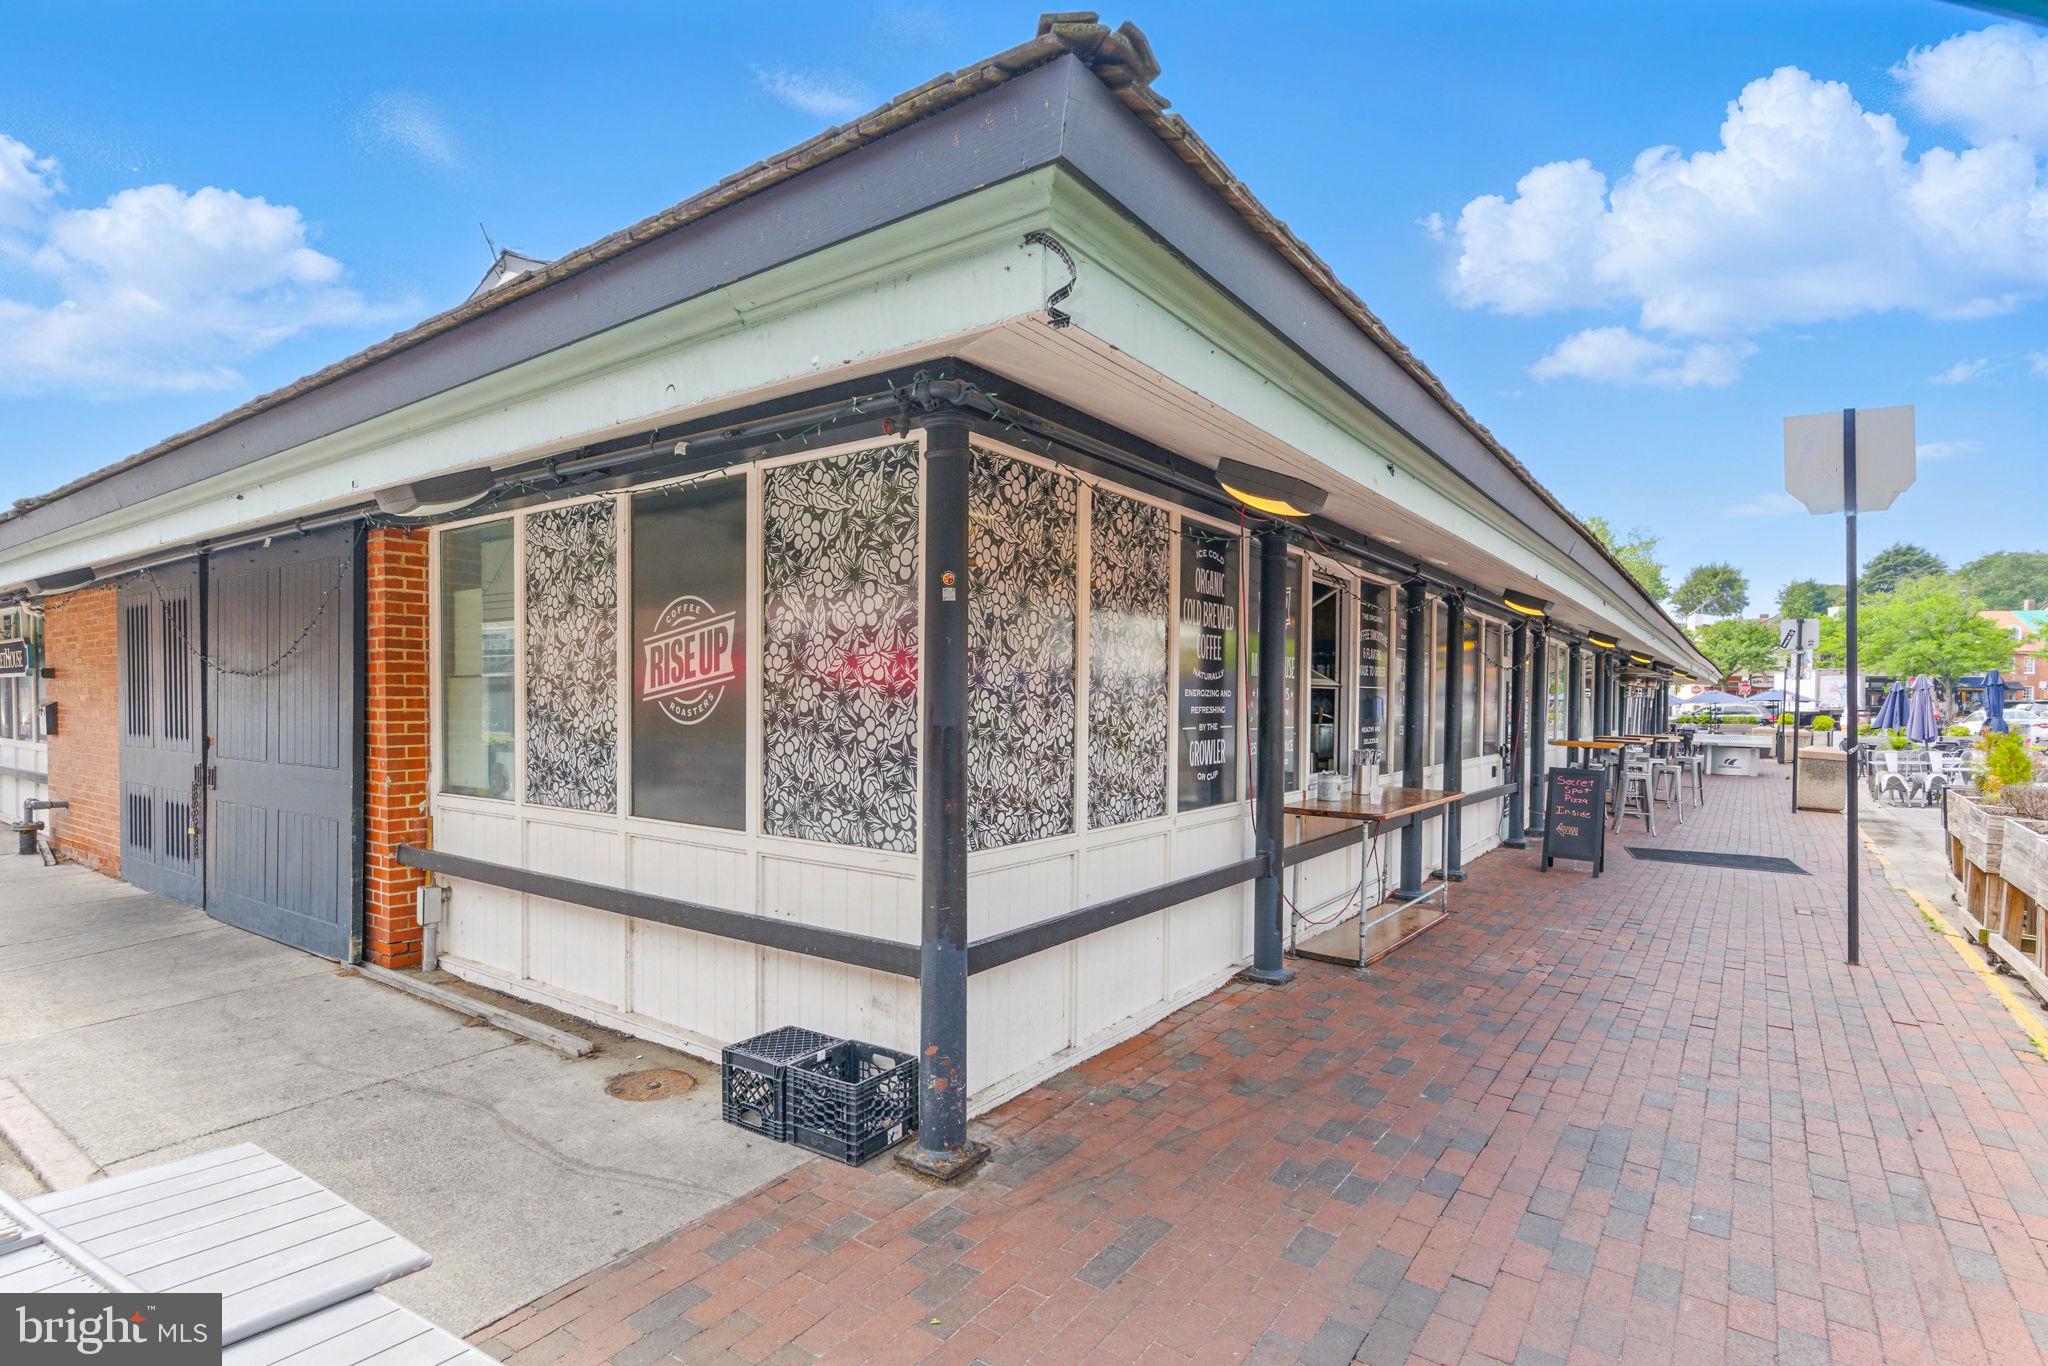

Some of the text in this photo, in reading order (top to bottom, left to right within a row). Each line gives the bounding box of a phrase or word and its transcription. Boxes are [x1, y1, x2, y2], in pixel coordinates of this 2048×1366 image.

[1195, 549, 1225, 565] ICE COLD
[1195, 567, 1225, 598] ORGANIC
[665, 603, 701, 623] COFFEE
[1183, 598, 1235, 631] COLD BREWED
[1196, 633, 1222, 661] COFFEE
[650, 625, 729, 689] RISE UP
[1192, 667, 1225, 681] NATURALLY
[1184, 689, 1232, 698] ENERGIZING AND
[669, 692, 714, 717] ROASTERS
[1190, 706, 1226, 714] REFRESHING
[1198, 723, 1218, 731] BY THE
[1189, 739, 1226, 767] GROWLER
[1197, 770, 1219, 781] OR CUP
[1557, 775, 1594, 786] Secret
[1564, 785, 1592, 795] Spot
[1564, 794, 1588, 804] Pizza
[1555, 805, 1591, 818] Inside
